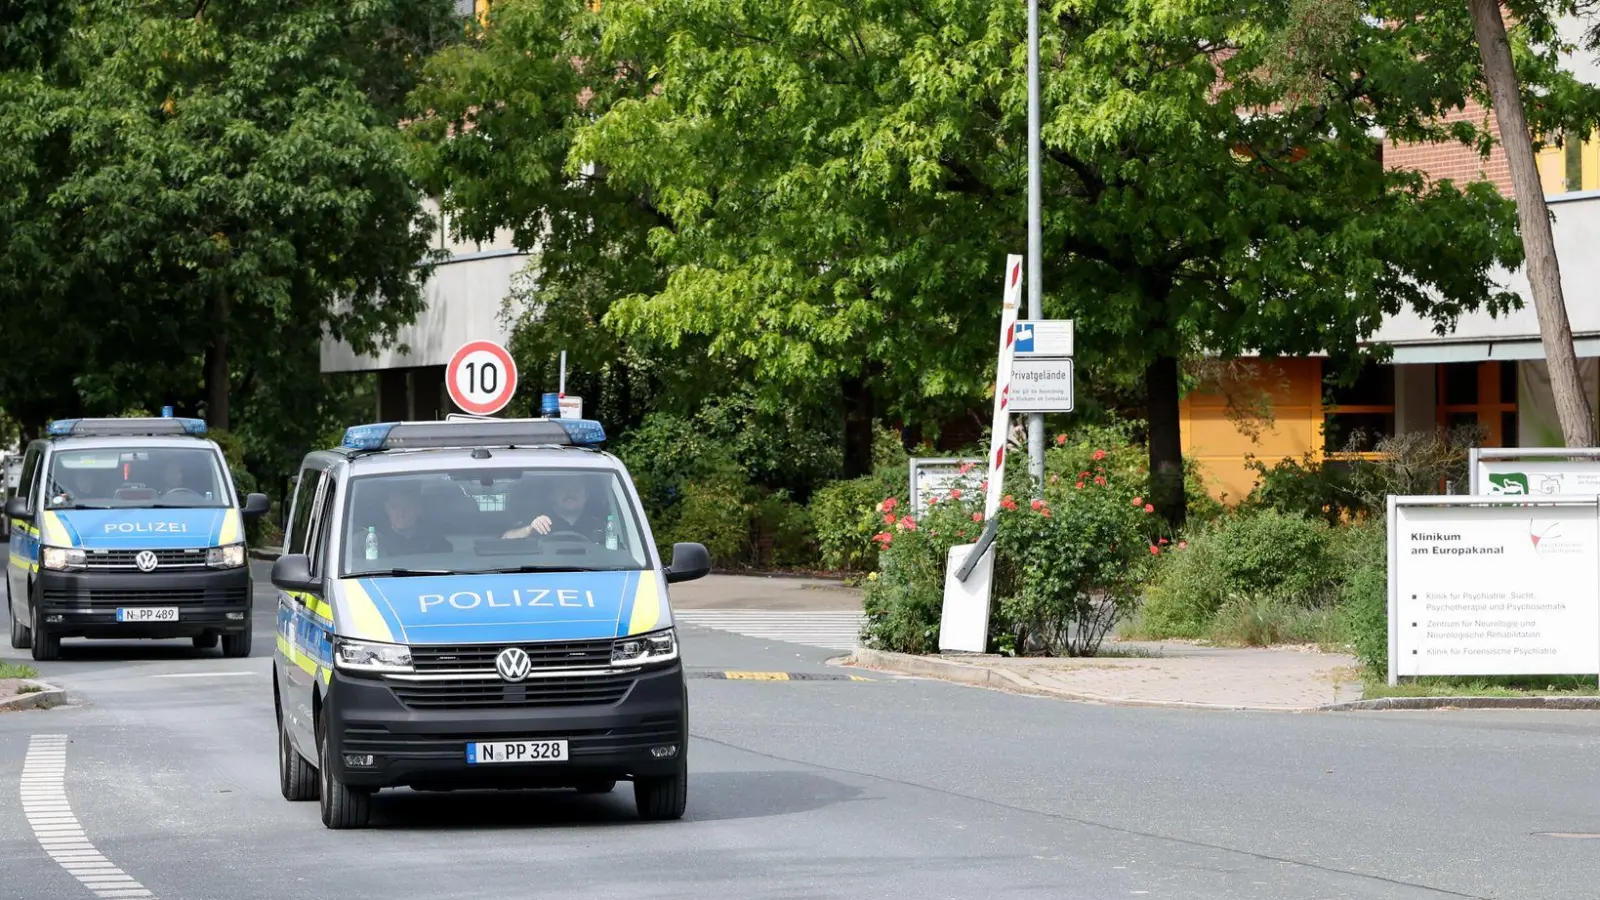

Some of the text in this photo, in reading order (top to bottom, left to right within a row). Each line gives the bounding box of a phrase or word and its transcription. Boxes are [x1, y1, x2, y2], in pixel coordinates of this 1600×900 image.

[466, 362, 497, 394] 10
[104, 522, 187, 534] POLIZEI
[1411, 532, 1461, 541] Klinikum
[1411, 546, 1504, 556] am Europakanal
[418, 589, 595, 613] POLIZEI
[1426, 591, 1448, 600] Klinik
[1426, 601, 1567, 612] Psychotherapie und Psychosomatik
[126, 609, 174, 620] N PP 489
[1427, 620, 1460, 628] Zentrum
[1474, 619, 1518, 629] Neurologie
[1520, 619, 1536, 628] und
[1427, 630, 1541, 641] Neurologische Rehabilitation
[1427, 647, 1448, 656] Klinik
[1463, 647, 1511, 655] Forensische
[1513, 646, 1557, 657] Psychiatrie
[482, 742, 561, 761] N PP 328
